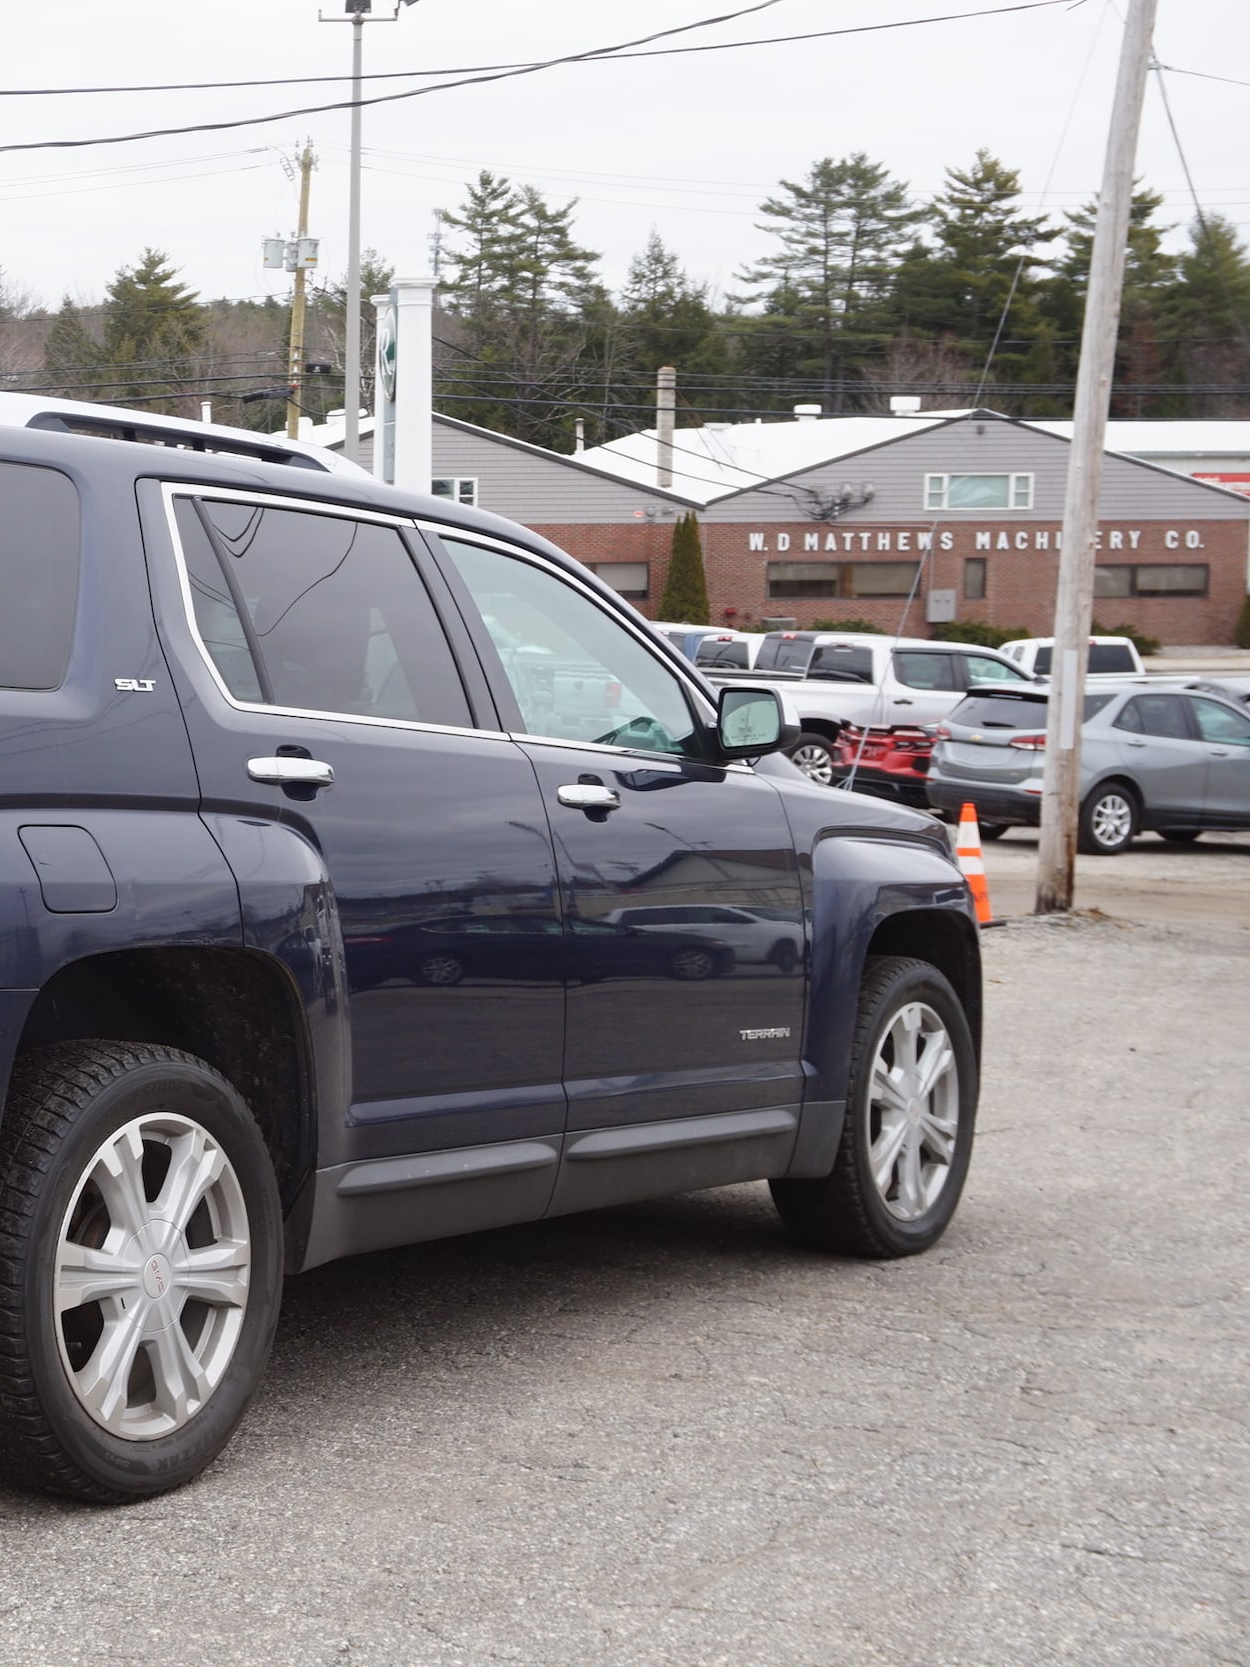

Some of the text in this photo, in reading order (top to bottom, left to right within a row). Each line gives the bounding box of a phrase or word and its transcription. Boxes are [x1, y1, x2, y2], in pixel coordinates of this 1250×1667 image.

[804, 531, 954, 551] MATTHEWS
[975, 530, 1142, 550] MACHIERY
[1164, 529, 1205, 549] CO.
[114, 678, 156, 692] SLT
[739, 1027, 791, 1041] TERRAIN
